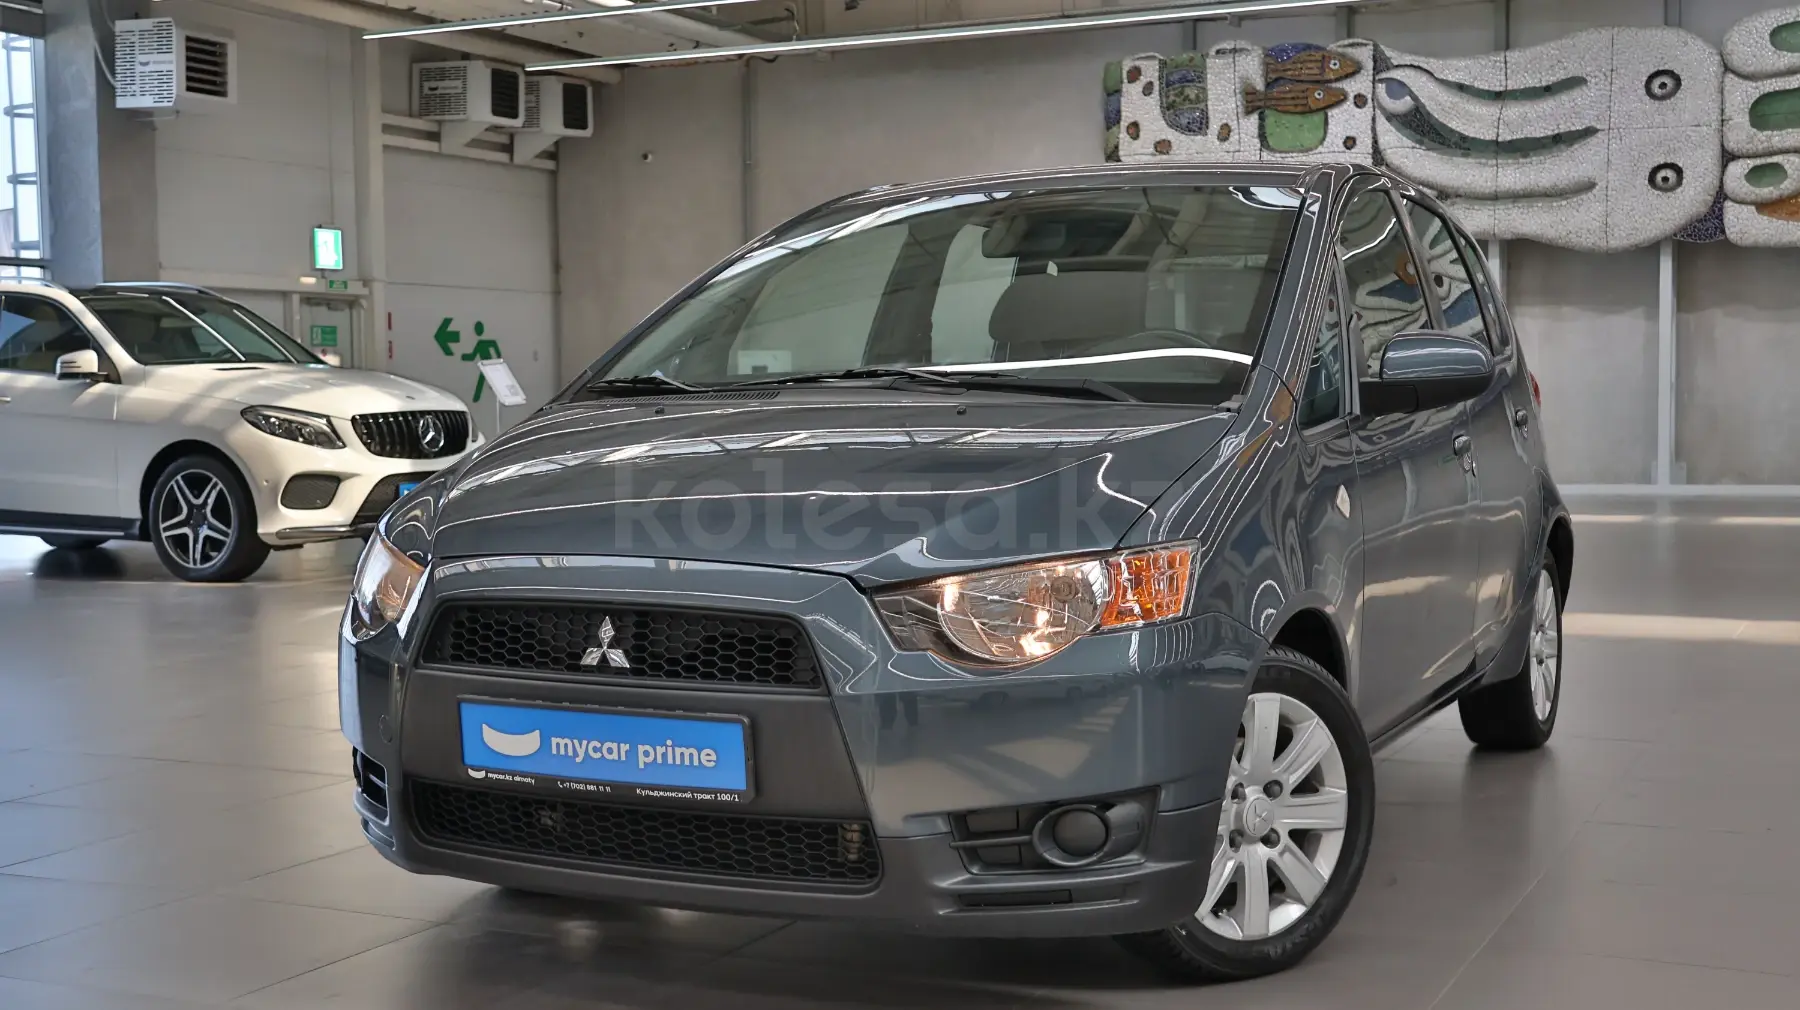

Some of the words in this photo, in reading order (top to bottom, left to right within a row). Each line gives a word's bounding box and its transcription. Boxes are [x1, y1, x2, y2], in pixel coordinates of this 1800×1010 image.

[550, 735, 630, 763] mycar
[637, 739, 717, 768] prime
[487, 772, 513, 781] mycar.kz
[636, 788, 693, 799] Кульджинский
[716, 793, 739, 802] 100/1
